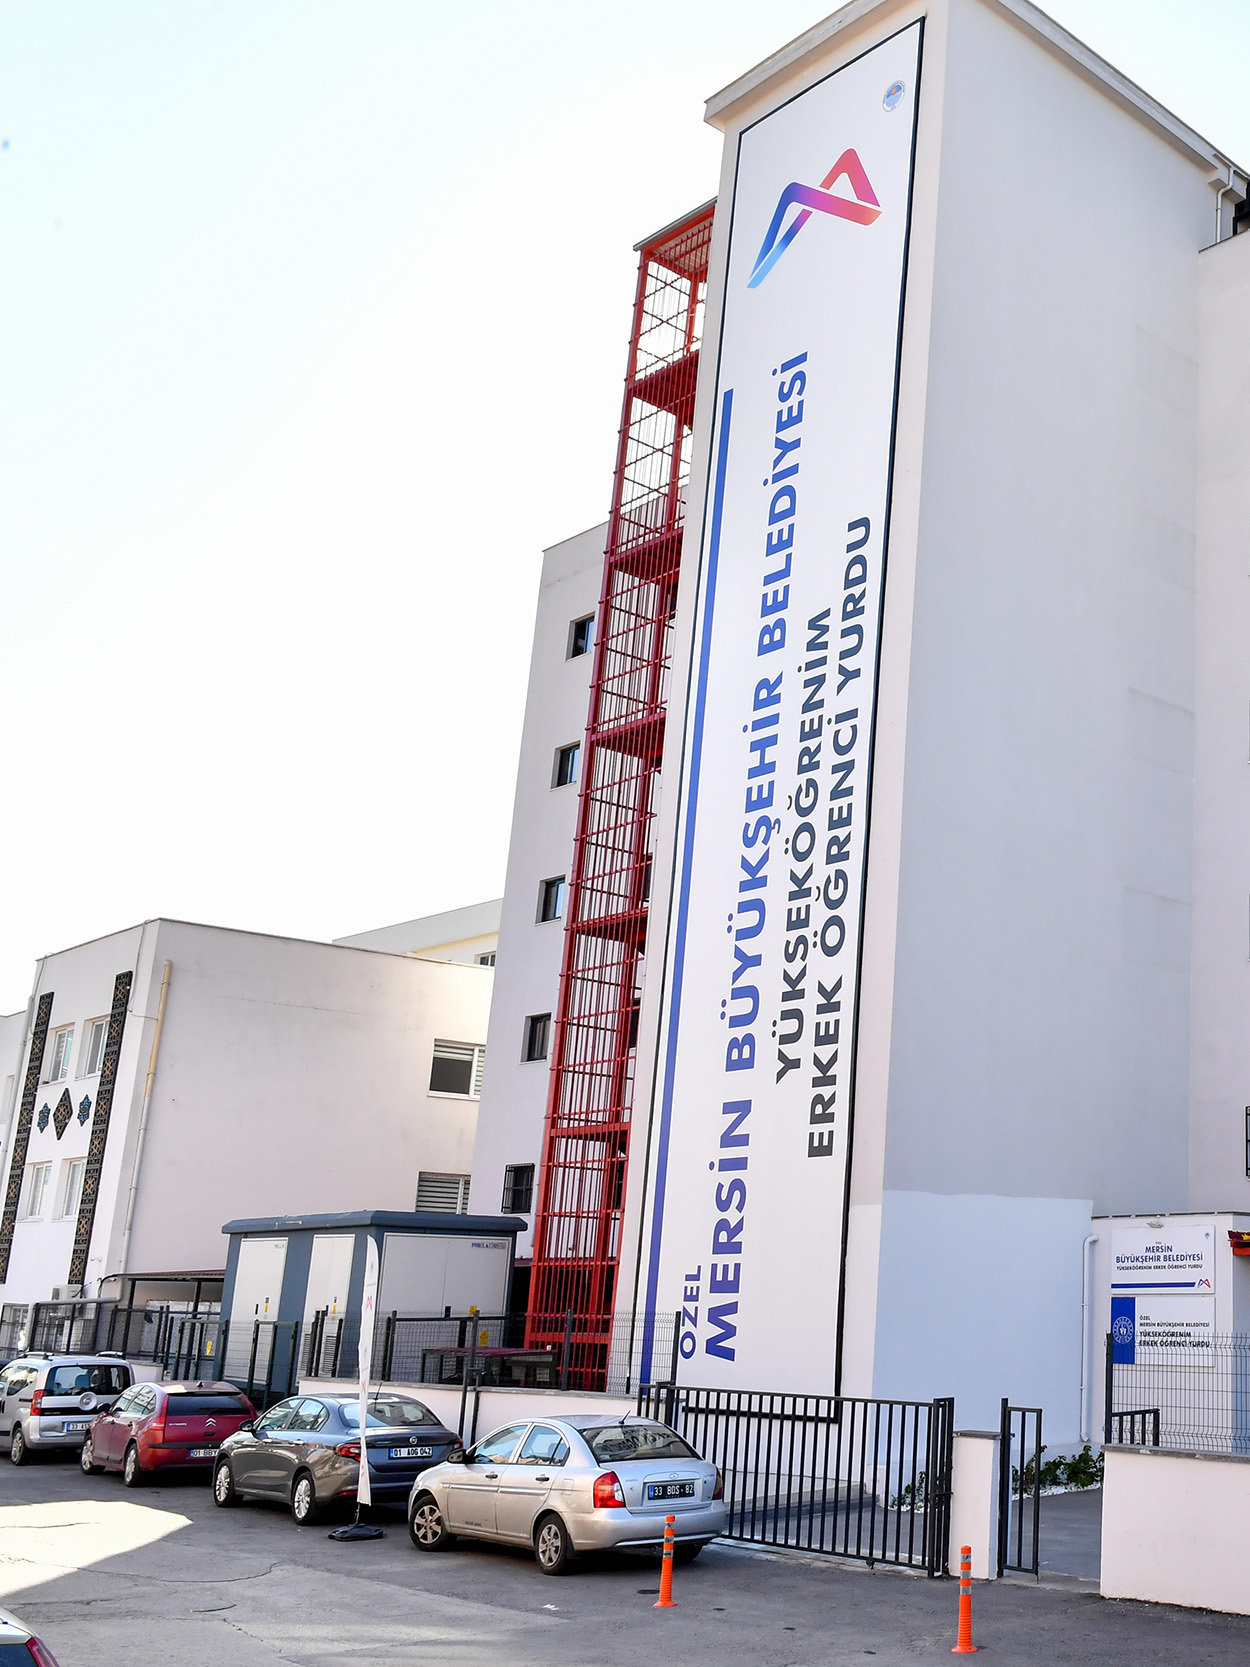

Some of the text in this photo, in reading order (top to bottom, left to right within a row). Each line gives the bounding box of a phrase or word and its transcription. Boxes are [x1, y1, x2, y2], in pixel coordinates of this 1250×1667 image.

[705, 351, 807, 1362] MERSİN BÜYÜKŞEHİR BELEDİYESİ
[771, 608, 832, 1085] YÜKSEKÖĞRENİM
[808, 517, 870, 1157] ERKEK ÖĞRENCİ YURDU
[1116, 1251, 1203, 1264] BÜYÜKŞEHİR BELEDİYESİ
[1145, 1243, 1173, 1253] MERSİN
[654, 1486, 663, 1495] 33
[685, 1484, 694, 1494] 82
